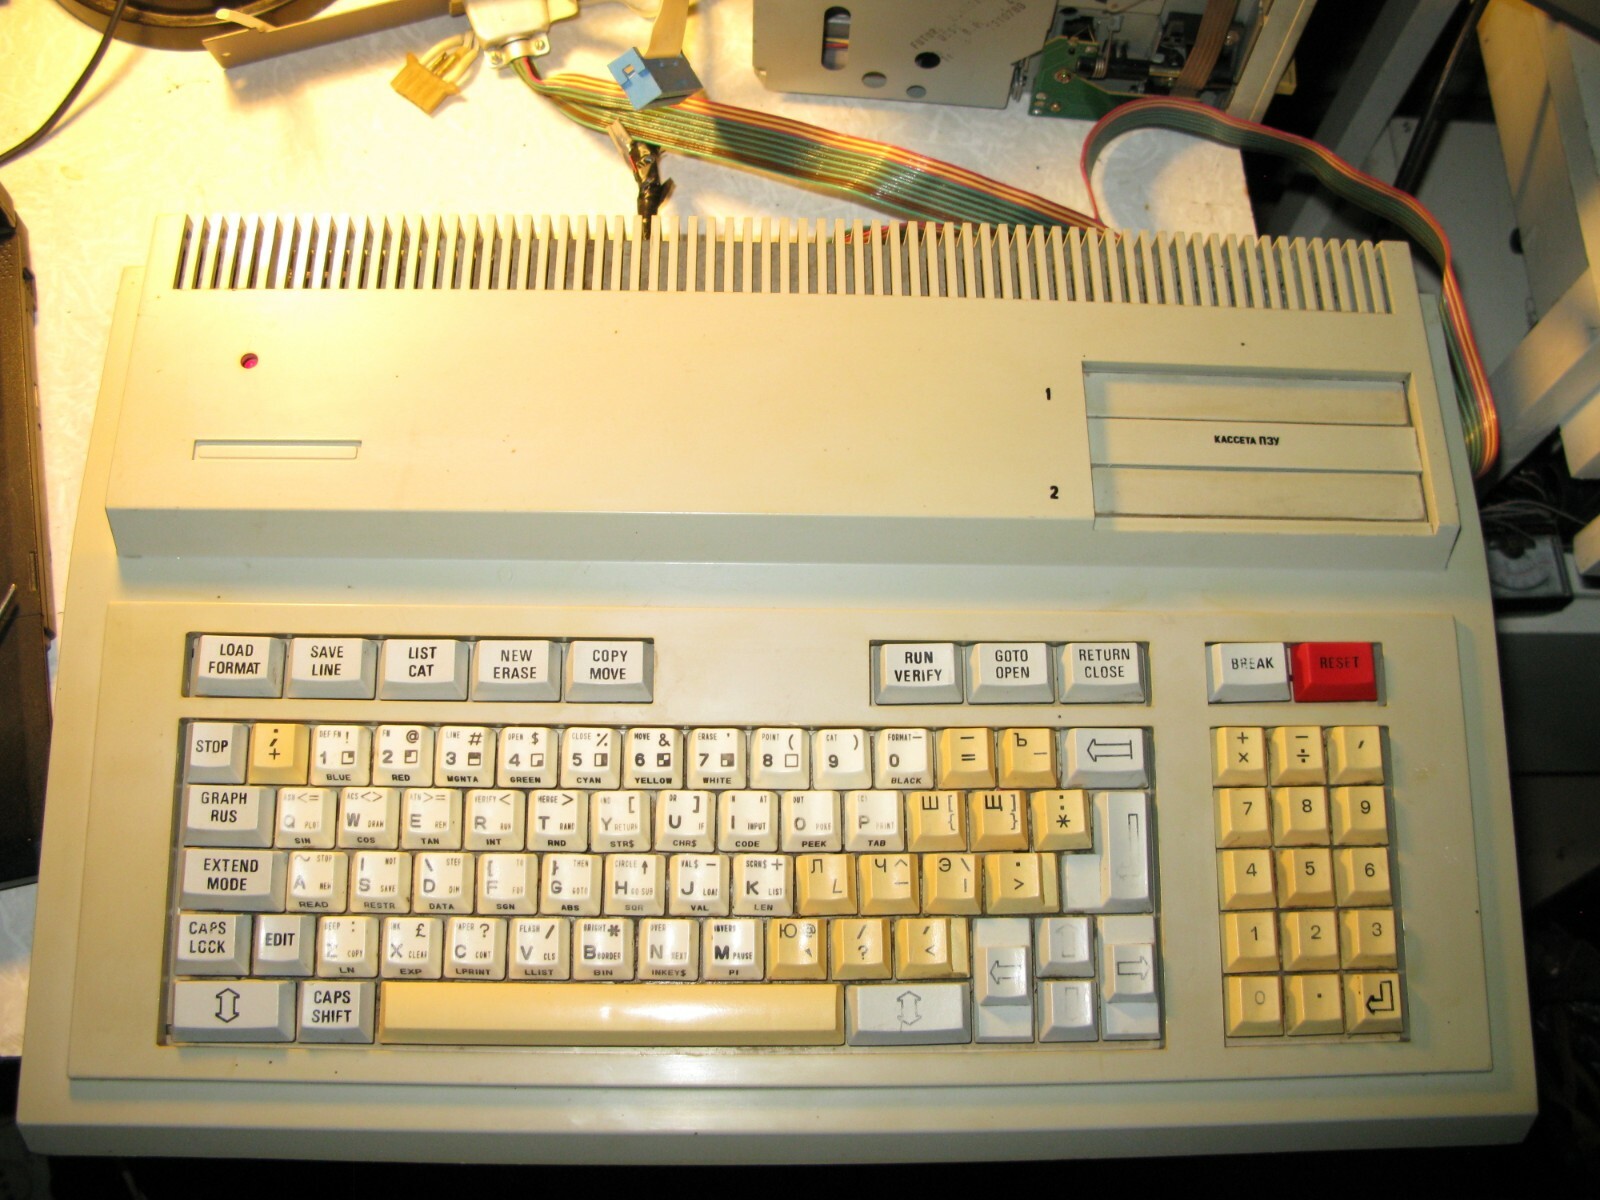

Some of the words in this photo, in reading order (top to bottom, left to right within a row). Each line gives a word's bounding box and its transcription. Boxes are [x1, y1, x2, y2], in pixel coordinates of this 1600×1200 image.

[1045, 387, 1051, 401] 1
[1214, 435, 1256, 445] КАССЕТА
[1259, 436, 1280, 446] ПЗУ
[1050, 485, 1059, 500] 2
[219, 643, 254, 657] LOAD
[310, 646, 344, 658] SAVE
[408, 646, 438, 660] LIST
[500, 649, 533, 662] NEW
[592, 649, 628, 662] COPY
[994, 649, 1029, 663] GOTO
[1078, 648, 1130, 662] RETURN
[904, 651, 934, 664] RUN
[1320, 656, 1360, 669] RESET
[208, 661, 261, 675] FORMAT
[312, 664, 341, 676] LINE
[408, 664, 434, 677] CAT
[493, 666, 537, 679] ERASE
[589, 667, 627, 680] MOVE
[995, 666, 1030, 679] OPEN
[1084, 665, 1125, 678] CLOSE
[894, 669, 943, 682] VERIFY
[572, 732, 591, 740] CLOSE
[826, 734, 838, 742] CAT
[887, 733, 912, 742] FORMAT
[1013, 732, 1027, 747] Ъ
[196, 739, 229, 753] STOP
[320, 751, 327, 764] 1
[382, 750, 394, 764] 2
[445, 752, 457, 765] 3
[508, 753, 521, 767] 4
[572, 753, 582, 766] 5
[634, 753, 645, 767] 6
[698, 753, 710, 767] 7
[762, 754, 773, 768] 8
[828, 754, 839, 768] 9
[326, 773, 351, 781] BLUE
[391, 774, 410, 782] RED
[447, 775, 479, 783] MGNTA
[201, 792, 248, 805] GRAPH
[537, 795, 558, 803] MERGE
[921, 795, 939, 810] Ш
[985, 795, 1003, 811] Щ
[1242, 801, 1253, 815] 7
[1302, 799, 1313, 813] 8
[1360, 800, 1371, 815] 9
[210, 809, 238, 823] RUS
[346, 813, 361, 827] W
[409, 814, 422, 828] E
[474, 816, 487, 830] R
[538, 816, 550, 830] T
[668, 814, 682, 829] U
[600, 817, 613, 831] Y
[610, 840, 635, 848] STR$
[672, 839, 697, 847] CHR$
[801, 840, 827, 848] PEEK
[203, 858, 259, 873] EXTEND
[874, 858, 887, 873] Ч
[938, 858, 952, 872] Э
[1246, 863, 1257, 877] 4
[1305, 861, 1316, 876] 5
[1364, 863, 1375, 877] 6
[207, 877, 248, 891] MODE
[293, 875, 306, 890] A
[358, 878, 371, 892] S
[423, 879, 436, 893] D
[550, 880, 563, 894] G
[614, 881, 628, 895] H
[681, 881, 694, 895] J
[746, 881, 759, 895] K
[768, 887, 783, 896] LIST
[189, 922, 227, 935] CAPS
[779, 923, 798, 938] Ю
[1250, 926, 1258, 941] 1
[1310, 925, 1322, 940] 2
[1371, 922, 1382, 937] 3
[265, 932, 296, 946] EDIT
[189, 940, 226, 954] LOCK
[390, 943, 403, 958] X
[454, 945, 467, 959] C
[520, 945, 533, 961] V
[583, 945, 596, 960] B
[650, 944, 663, 959] N
[714, 945, 729, 960] M
[543, 953, 556, 961] CLS
[732, 952, 753, 960] PAUSE
[455, 968, 491, 976] LPRINT
[313, 990, 351, 1004] CAPS
[311, 1009, 352, 1023] SHIFT
